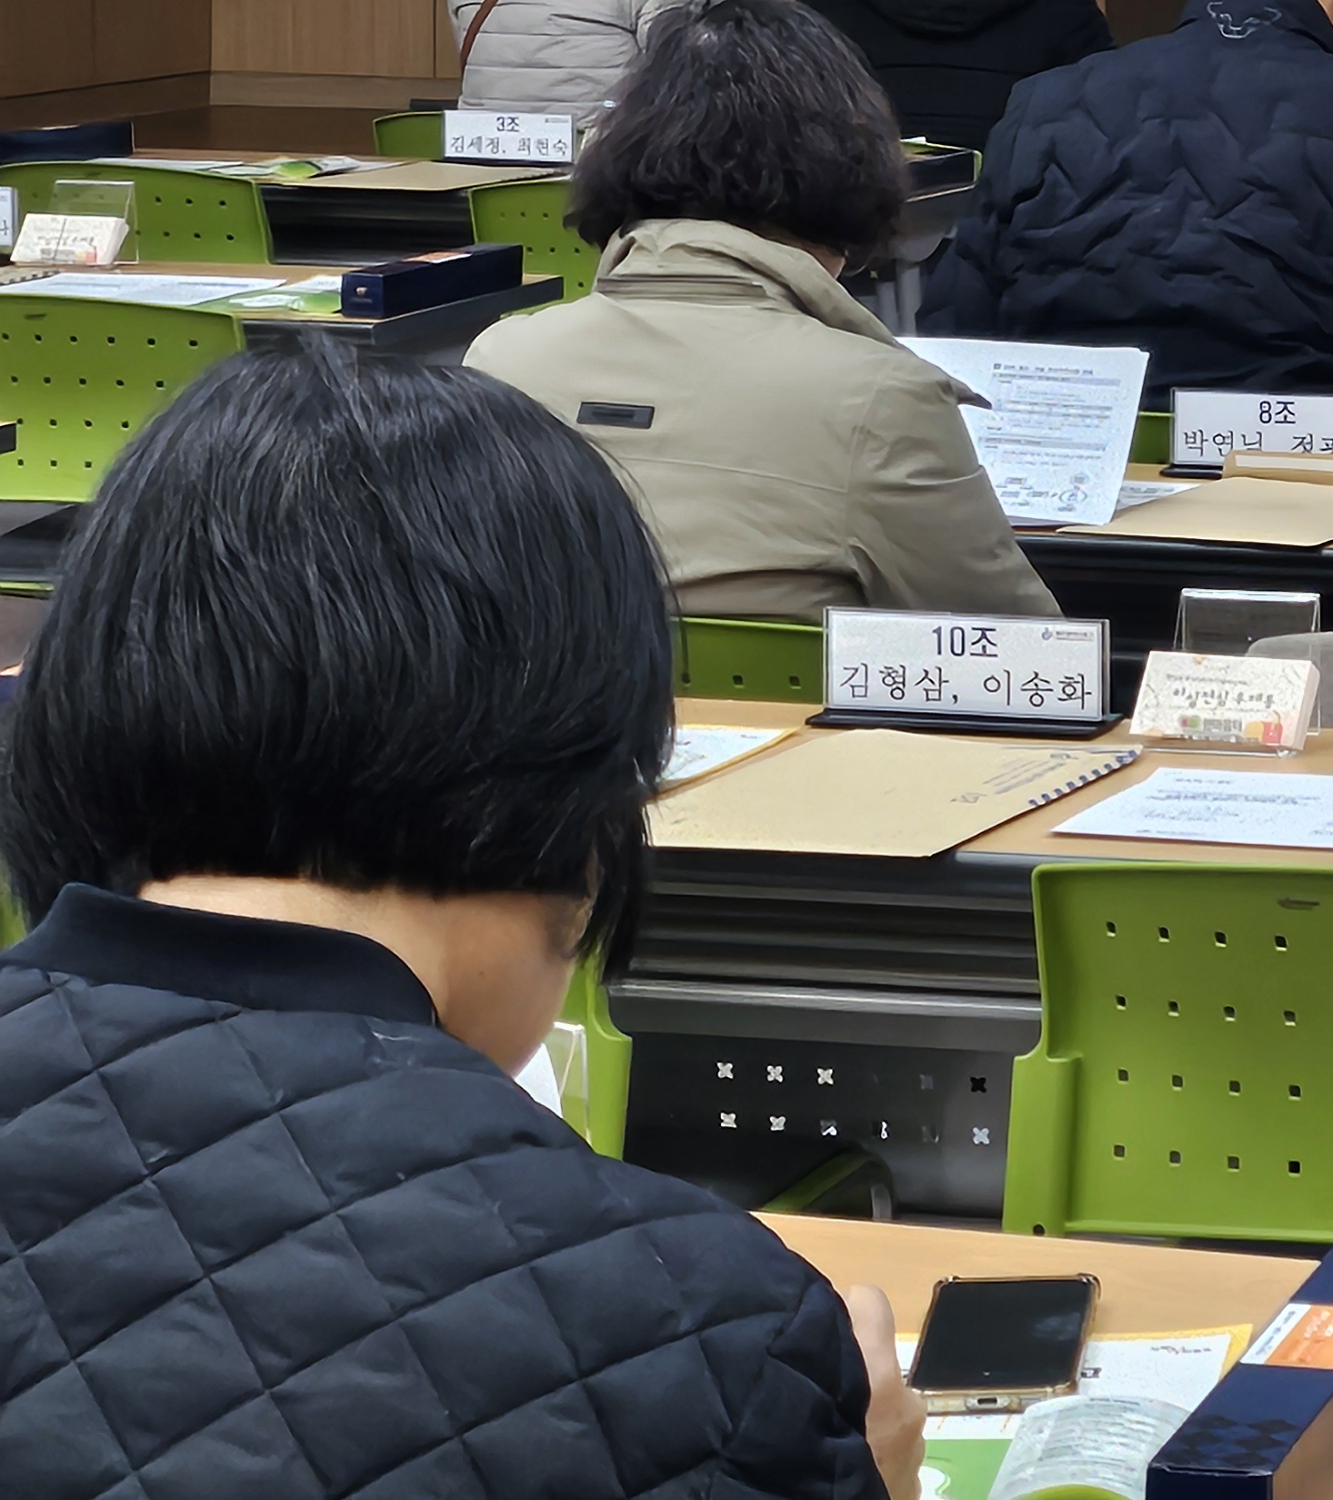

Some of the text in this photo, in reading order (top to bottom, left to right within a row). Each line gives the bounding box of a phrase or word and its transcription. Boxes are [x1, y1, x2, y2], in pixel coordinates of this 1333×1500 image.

[496, 116, 520, 132] 3조
[1259, 400, 1297, 424] 8조
[931, 625, 999, 658] 10조
[839, 662, 1093, 711] 김형삼, 이송화
